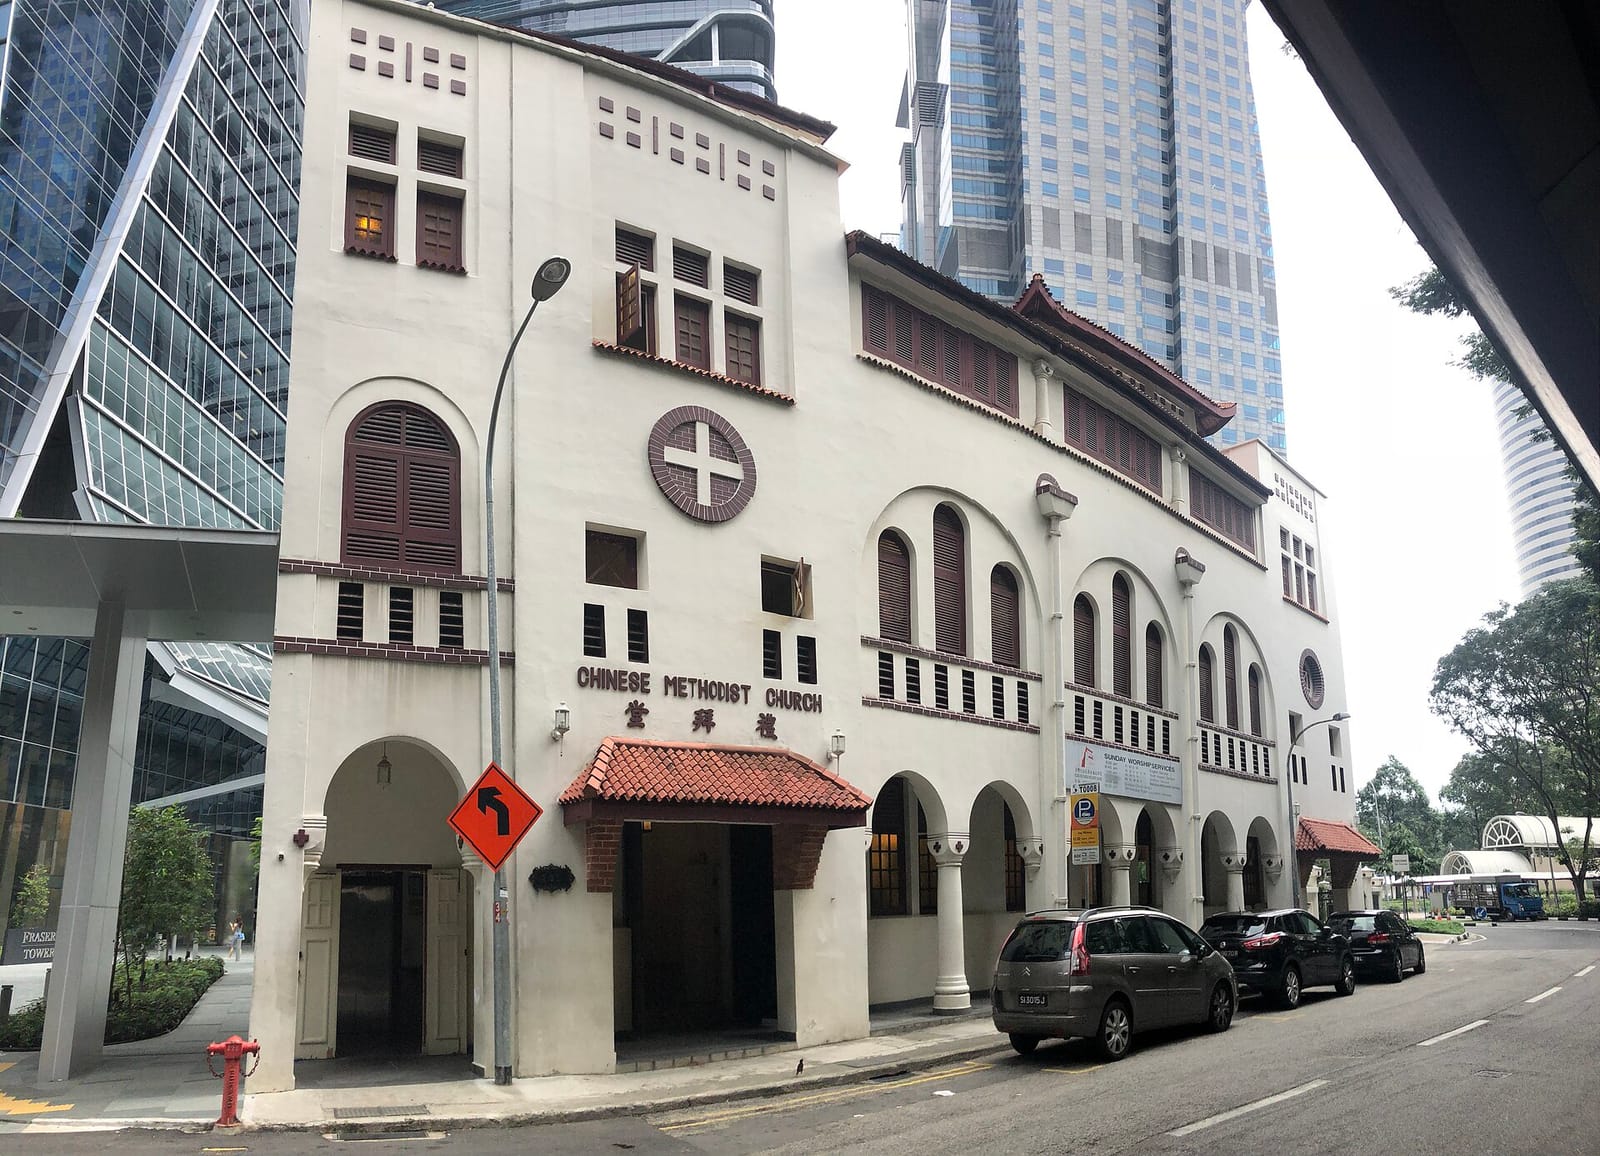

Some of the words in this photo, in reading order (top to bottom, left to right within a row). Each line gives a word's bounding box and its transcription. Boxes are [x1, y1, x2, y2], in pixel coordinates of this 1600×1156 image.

[577, 665, 650, 694] CHINESE
[663, 675, 751, 704] METHODIST
[765, 688, 822, 713] CHURCH
[1104, 753, 1126, 763] SUNDAY
[1151, 762, 1175, 773] SERVICES
[22, 931, 56, 943] FRASER
[24, 948, 55, 960] TOWER
